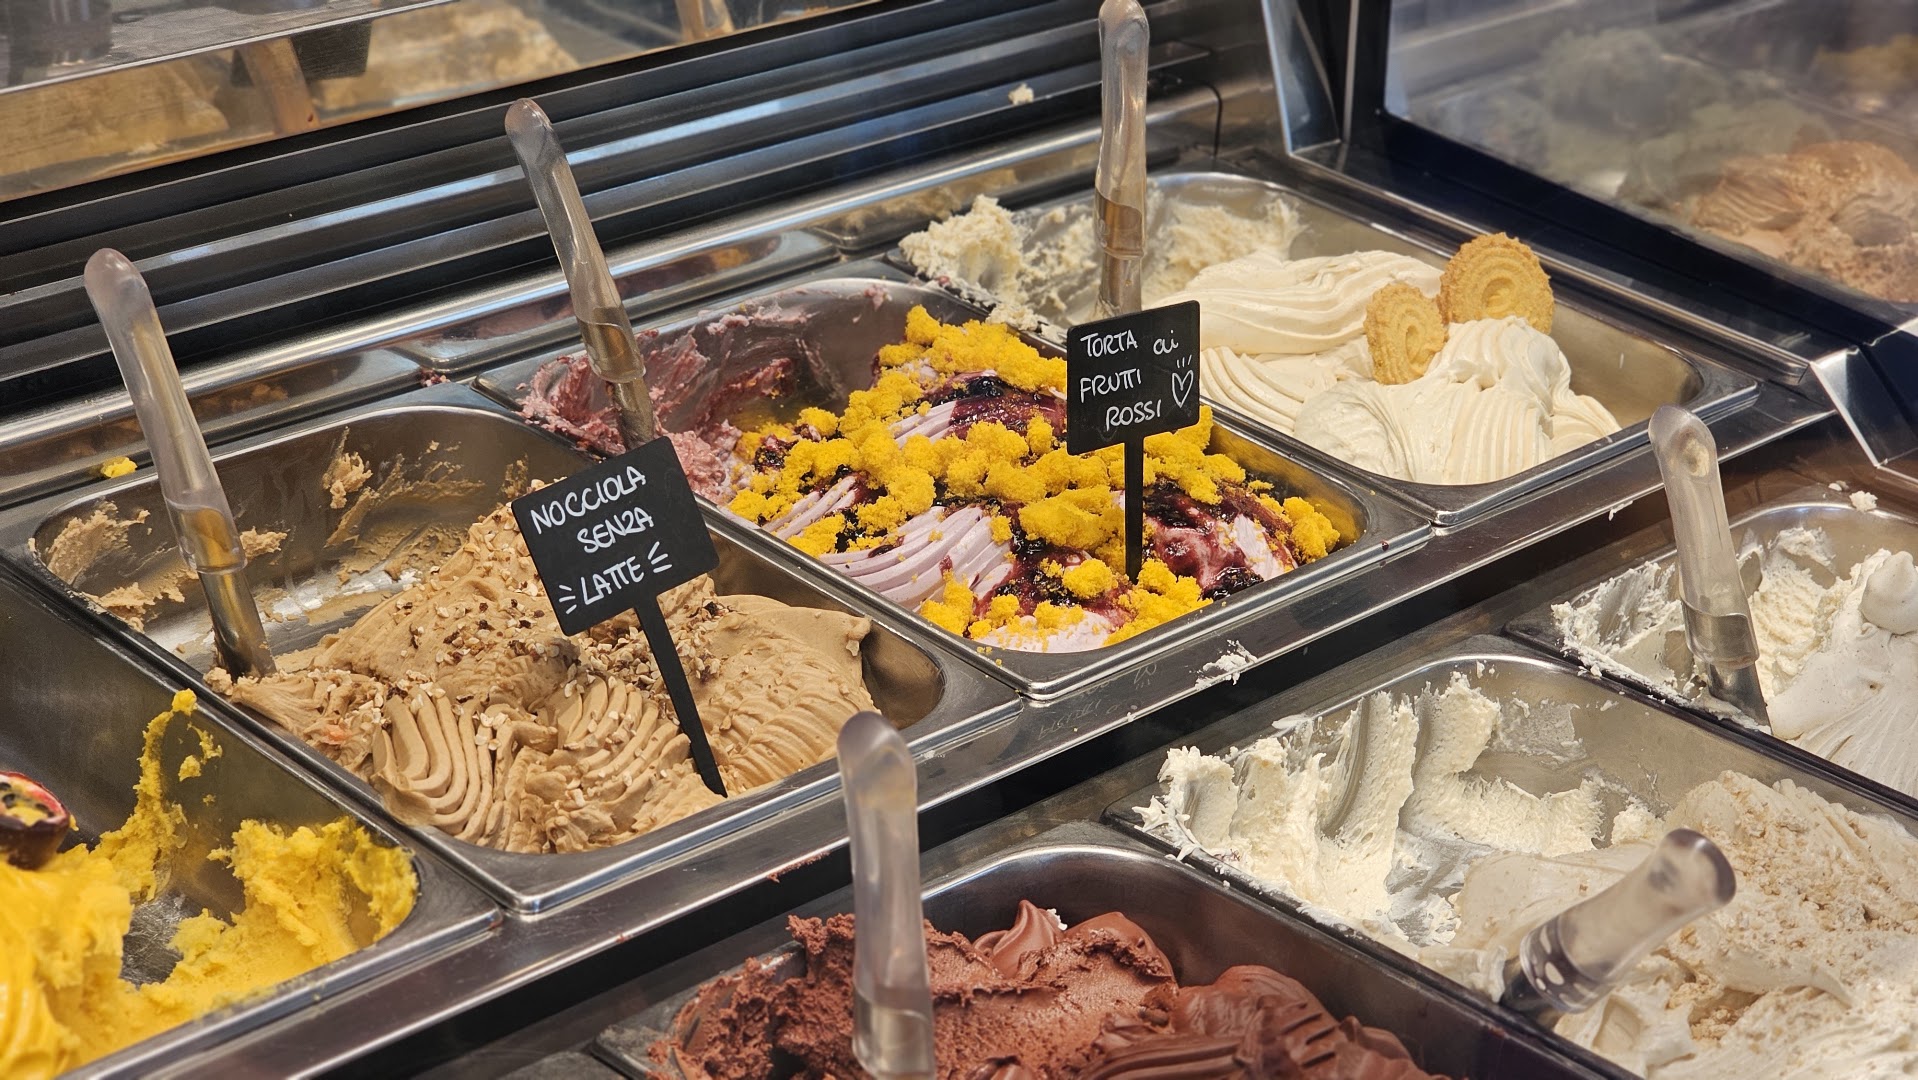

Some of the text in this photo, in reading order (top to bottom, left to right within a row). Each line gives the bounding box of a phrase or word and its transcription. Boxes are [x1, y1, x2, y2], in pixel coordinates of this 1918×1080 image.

[1080, 329, 1179, 358] TORTA ai
[1080, 368, 1142, 404] FRUTTI
[1106, 399, 1162, 432] ROSSI
[530, 465, 647, 535] NOCCIOLA
[576, 506, 655, 554] SENZA
[580, 555, 645, 606] LATTE
